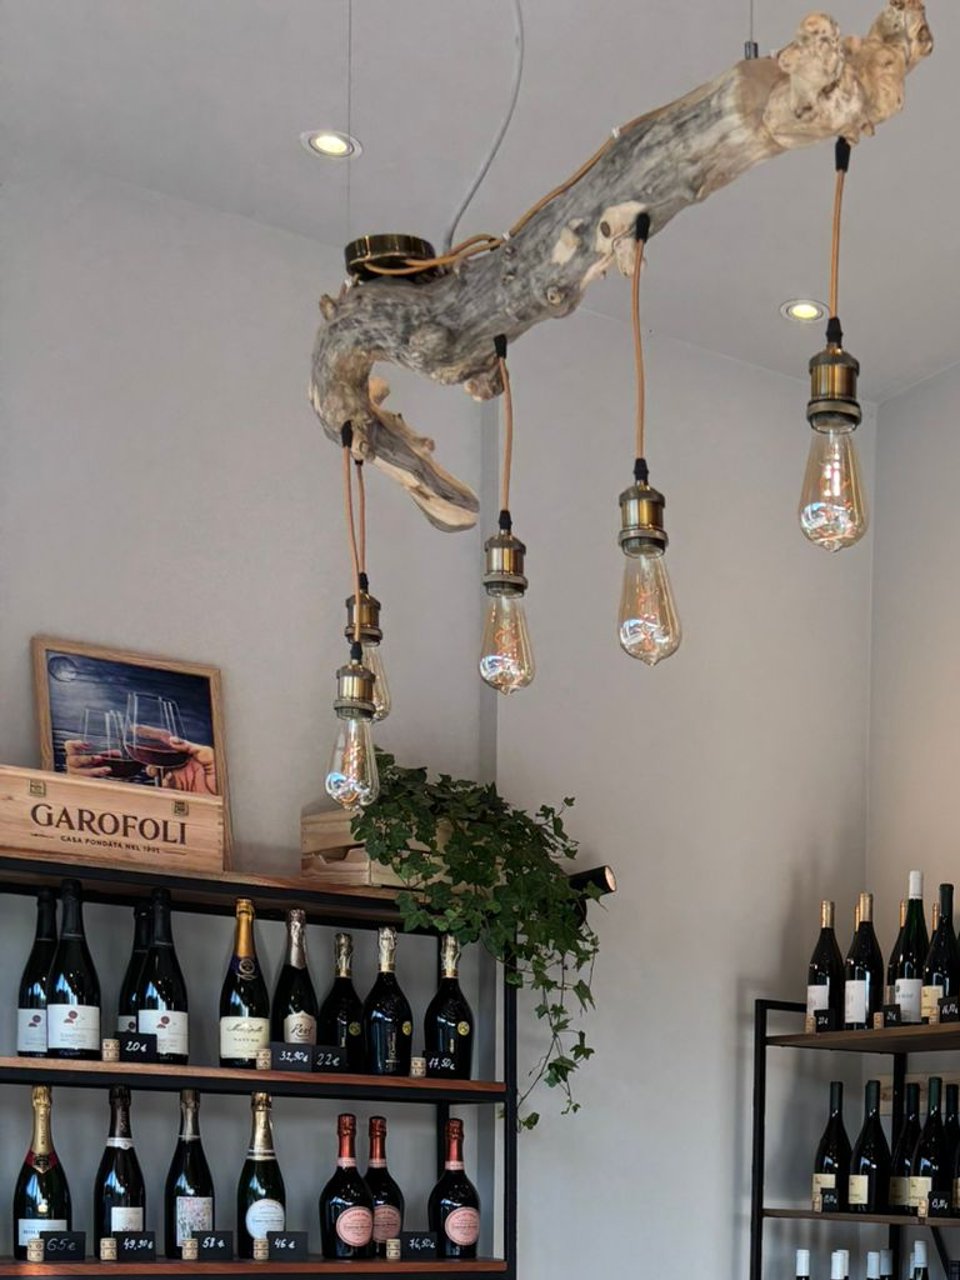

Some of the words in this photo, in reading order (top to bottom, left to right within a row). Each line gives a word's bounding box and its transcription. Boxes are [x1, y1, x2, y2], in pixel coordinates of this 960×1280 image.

[30, 803, 187, 846] GAROFOLI
[60, 834, 83, 844] CASA
[125, 1040, 148, 1052] 20€
[46, 1237, 77, 1251] 65€
